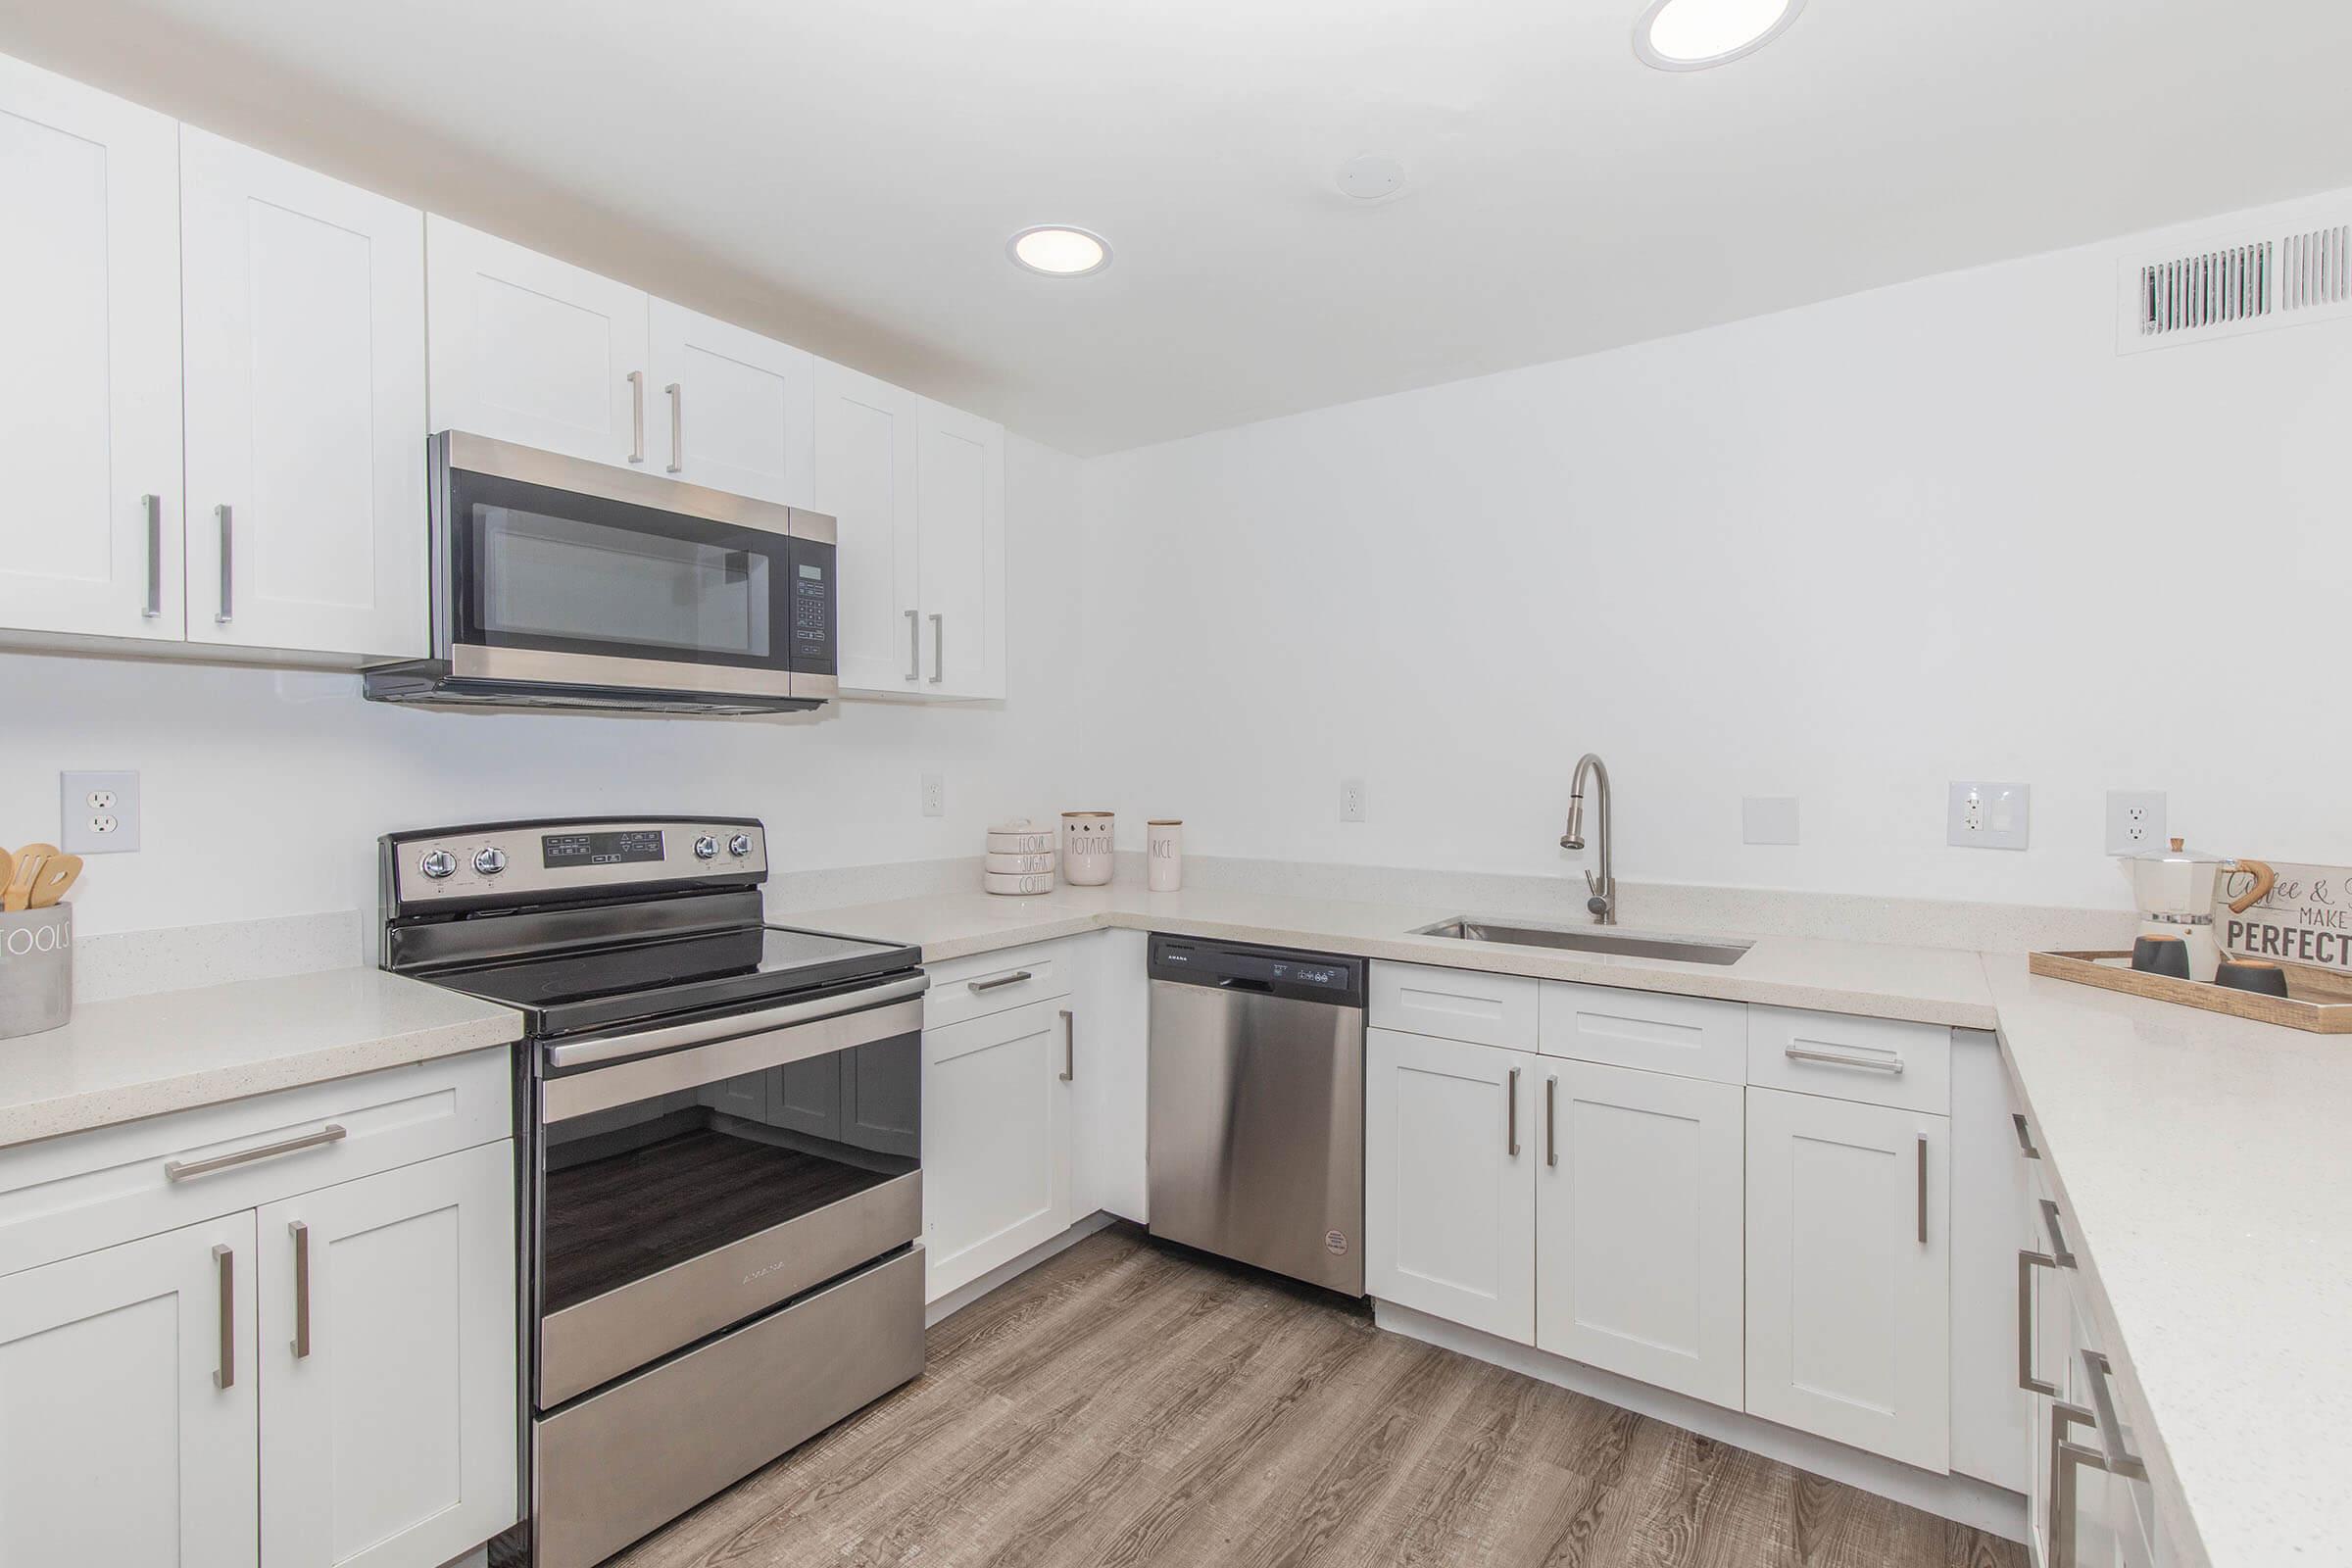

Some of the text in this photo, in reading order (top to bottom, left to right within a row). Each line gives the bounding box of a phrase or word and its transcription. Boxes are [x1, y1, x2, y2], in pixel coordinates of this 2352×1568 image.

[1152, 839, 1172, 858] RICE
[1021, 855, 1049, 871] SUGAR
[2227, 870, 2302, 905] Cofee
[2310, 879, 2335, 905] &
[2299, 906, 2348, 929] MAKE
[2227, 919, 2352, 965] PERFECT
